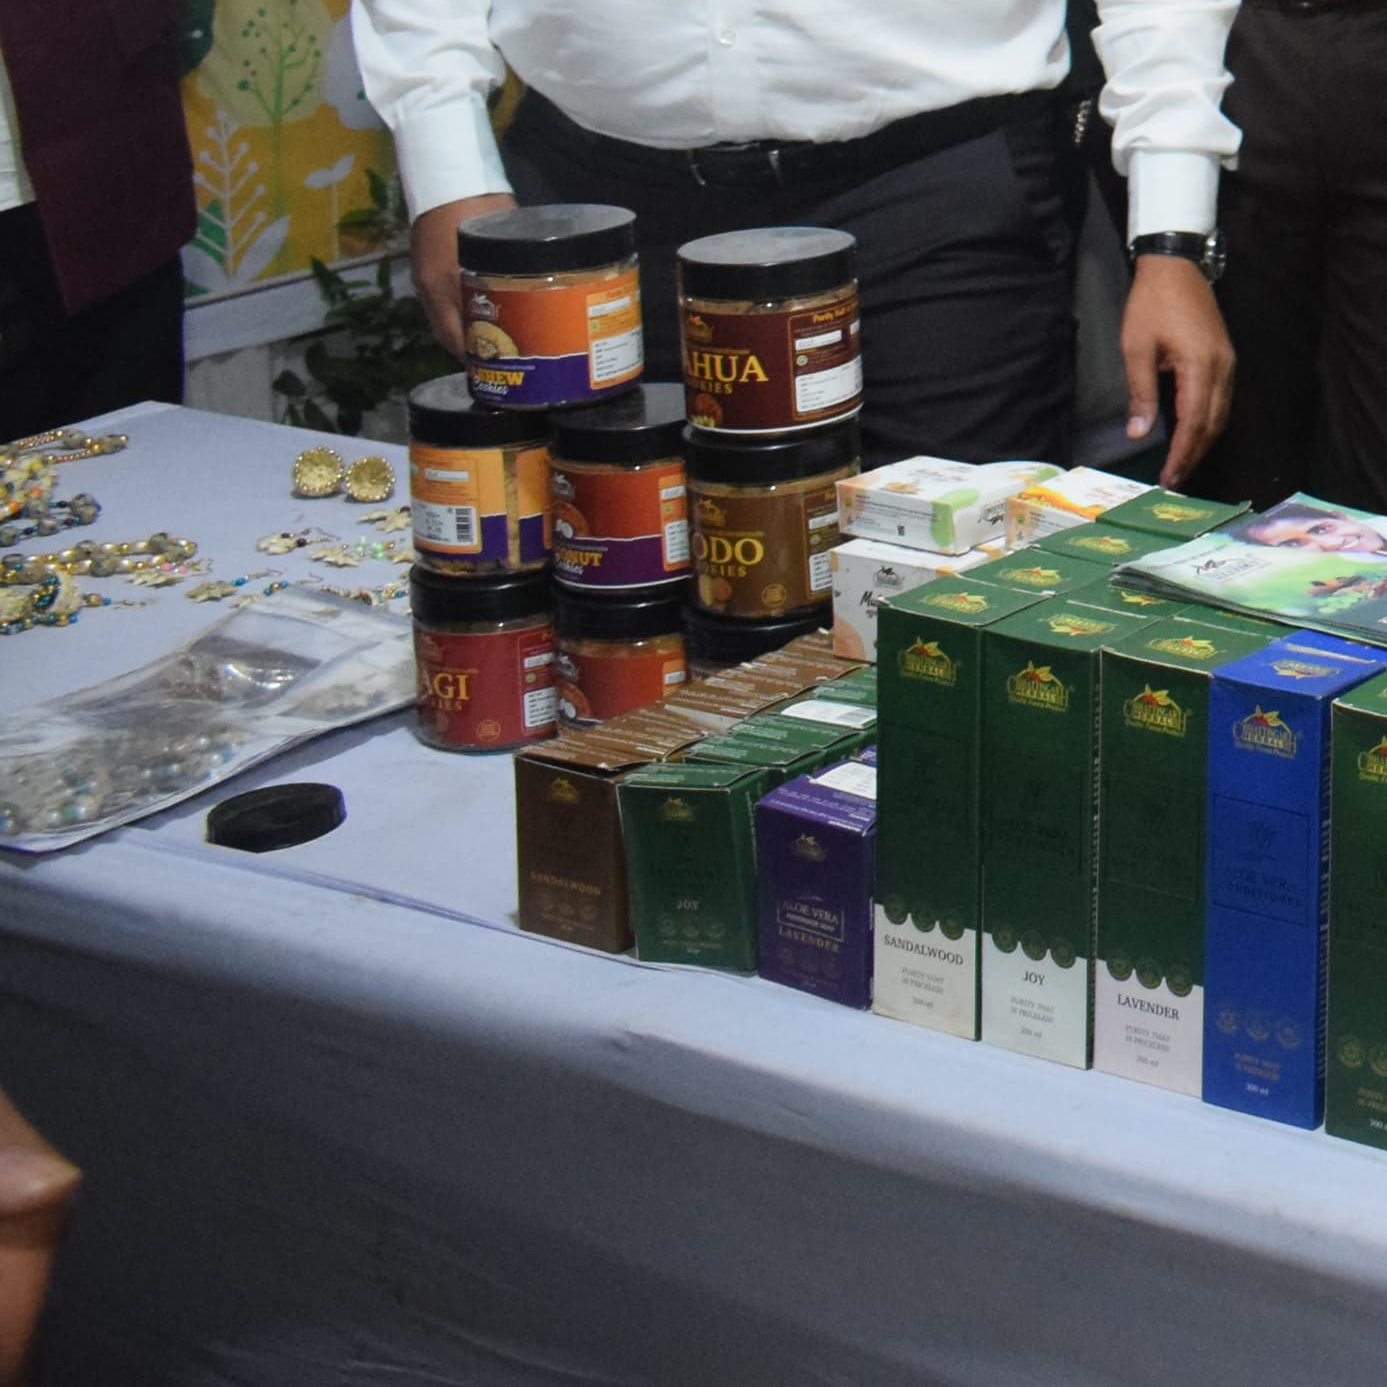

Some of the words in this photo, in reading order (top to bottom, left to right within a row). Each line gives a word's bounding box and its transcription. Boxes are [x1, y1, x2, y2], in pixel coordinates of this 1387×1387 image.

[691, 532, 765, 565] ODO
[677, 899, 699, 911] JOY
[782, 900, 810, 917] ALOE
[813, 907, 840, 925] VERA
[779, 926, 840, 953] LAVENDER
[883, 934, 964, 966] SANDALWOOD
[1023, 970, 1045, 986] JOY
[1117, 993, 1180, 1022] LAVENDER
